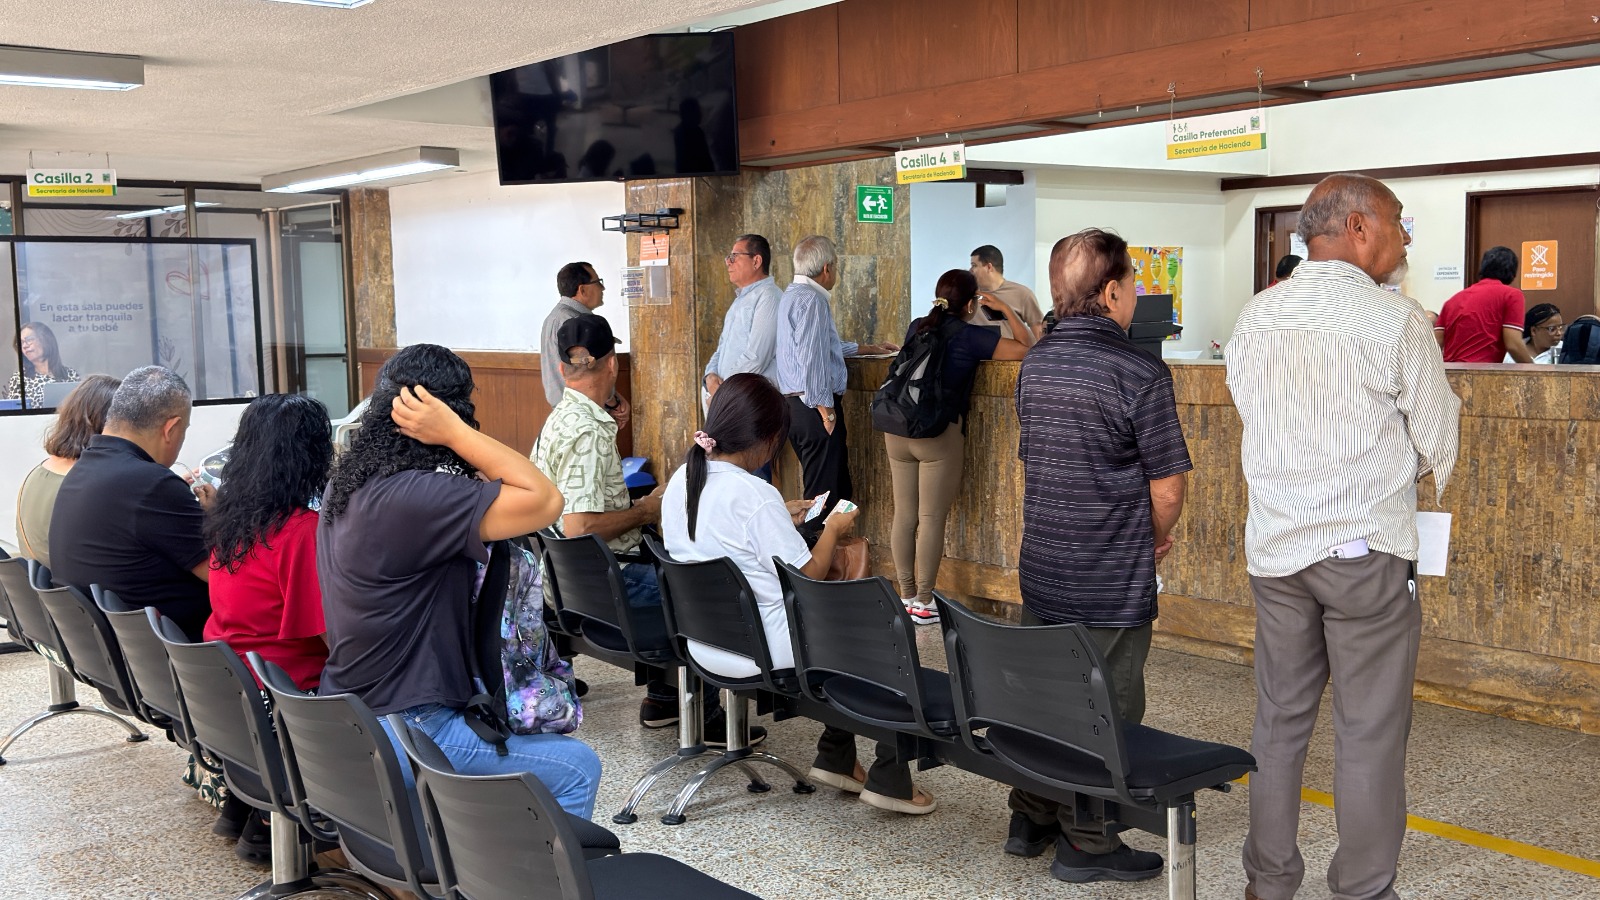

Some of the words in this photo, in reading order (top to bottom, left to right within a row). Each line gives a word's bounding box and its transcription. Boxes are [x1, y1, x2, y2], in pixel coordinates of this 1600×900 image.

[1173, 132, 1198, 142] Casilla
[1200, 125, 1246, 138] Preferencial
[1218, 140, 1251, 150] Hacienda
[901, 154, 936, 168] Casilla
[939, 151, 947, 165] 4
[34, 172, 82, 184] Casilla
[85, 172, 94, 184] 2
[40, 303, 53, 311] En
[56, 303, 79, 311] esta
[81, 302, 103, 311] sala
[105, 302, 144, 311] puedes
[52, 313, 84, 322] lactar
[86, 312, 133, 322] tranquila
[77, 324, 89, 332] tu
[91, 322, 119, 332] bebé
